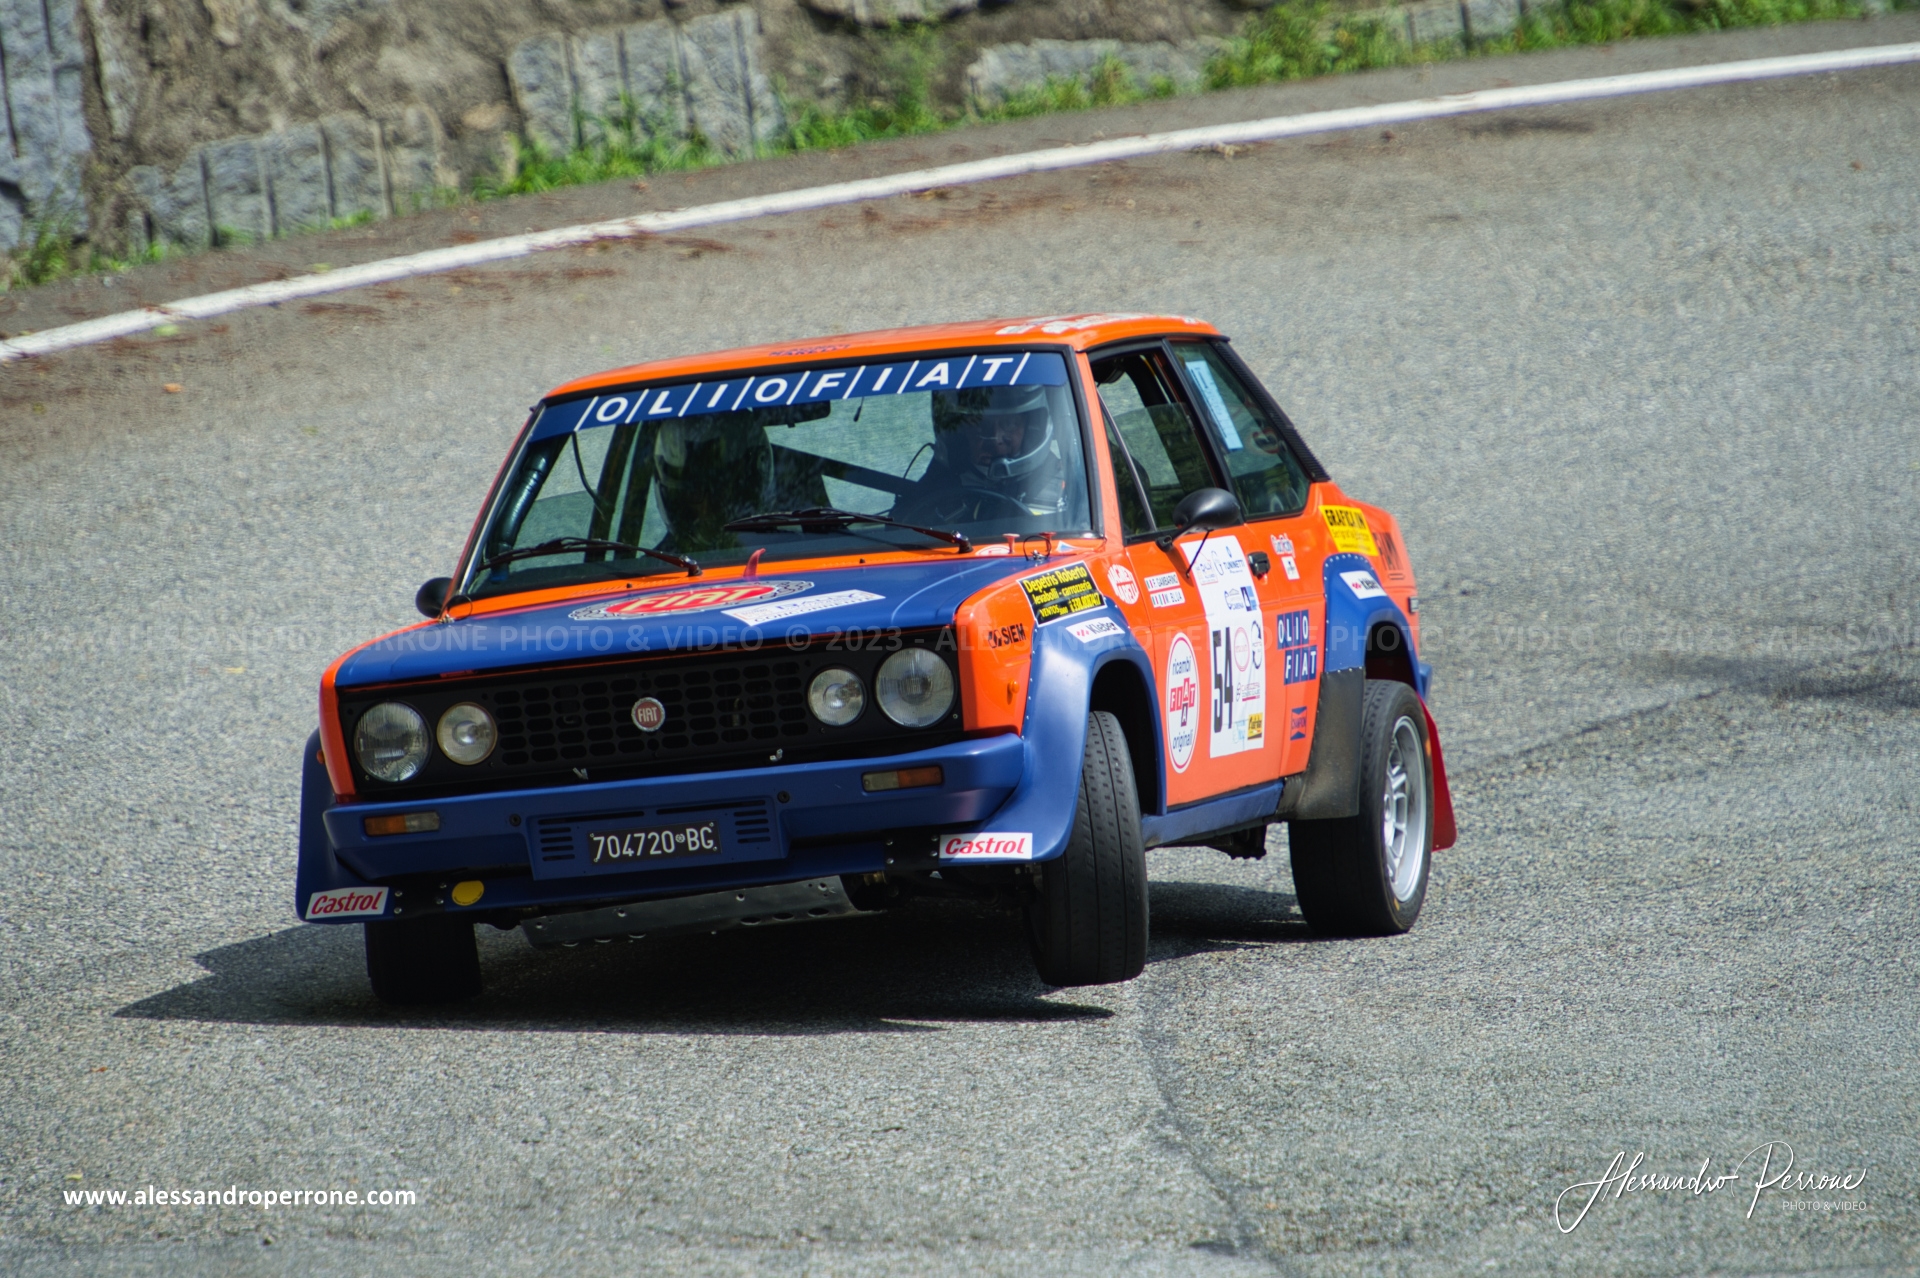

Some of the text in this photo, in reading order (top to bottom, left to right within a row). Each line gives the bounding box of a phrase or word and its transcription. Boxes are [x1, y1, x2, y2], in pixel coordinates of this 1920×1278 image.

[1022, 573, 1059, 594] Depetris
[1057, 565, 1088, 586] Roberto
[1062, 579, 1093, 598] carrozzeria
[625, 587, 763, 613] FIAT
[1000, 622, 1027, 645] SIEM
[1086, 621, 1118, 636] Kleber
[1278, 615, 1309, 644] OLIO
[1172, 655, 1192, 676] ricambi
[1285, 650, 1317, 679] FIAT
[1212, 626, 1233, 734] 54
[637, 707, 658, 723] FIAT
[1172, 729, 1194, 753] originali
[593, 826, 714, 862] 704720 BG
[944, 837, 1026, 856] Castrol
[311, 890, 384, 916] Castrol
